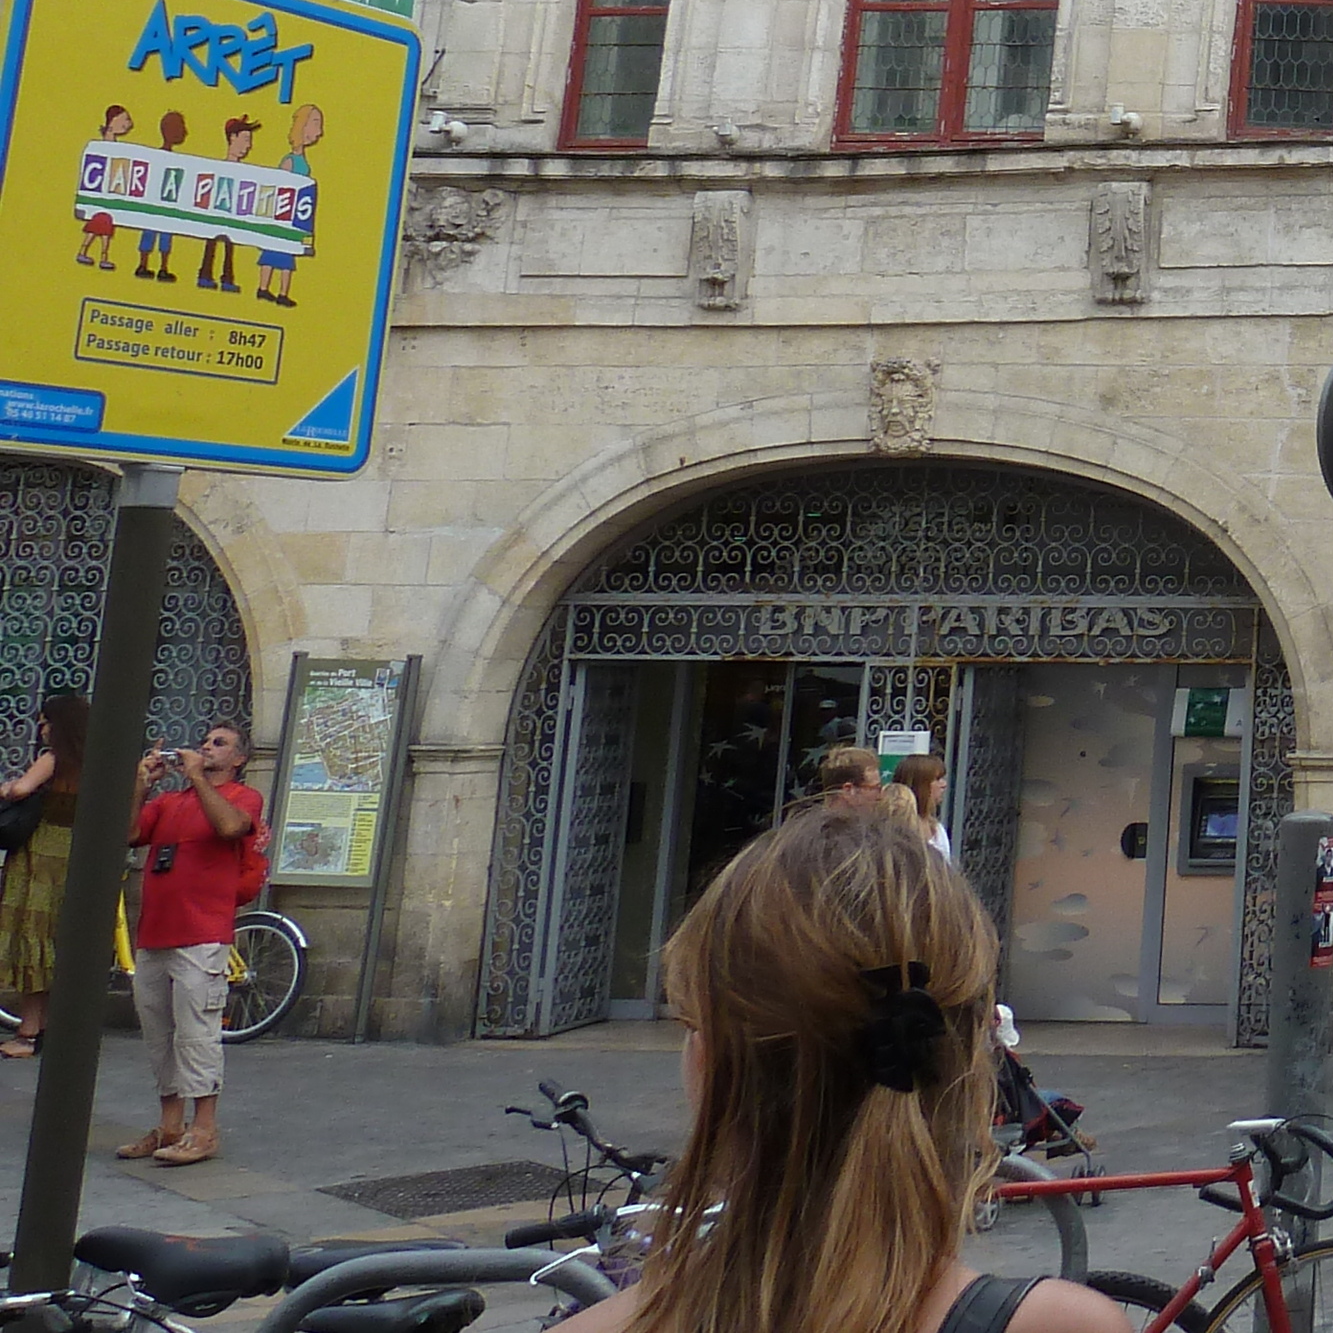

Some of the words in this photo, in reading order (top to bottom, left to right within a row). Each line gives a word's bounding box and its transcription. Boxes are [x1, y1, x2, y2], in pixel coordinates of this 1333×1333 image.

[83, 162, 144, 194] CAR
[197, 177, 313, 221] PATTES
[90, 309, 154, 333] Passage
[164, 321, 199, 338] aller
[228, 330, 267, 348] 8h47
[86, 333, 150, 357] Passage
[154, 346, 203, 363] retour
[216, 351, 264, 370] 17h00
[759, 605, 890, 636] BNP
[903, 605, 1172, 636] PARIBAS
